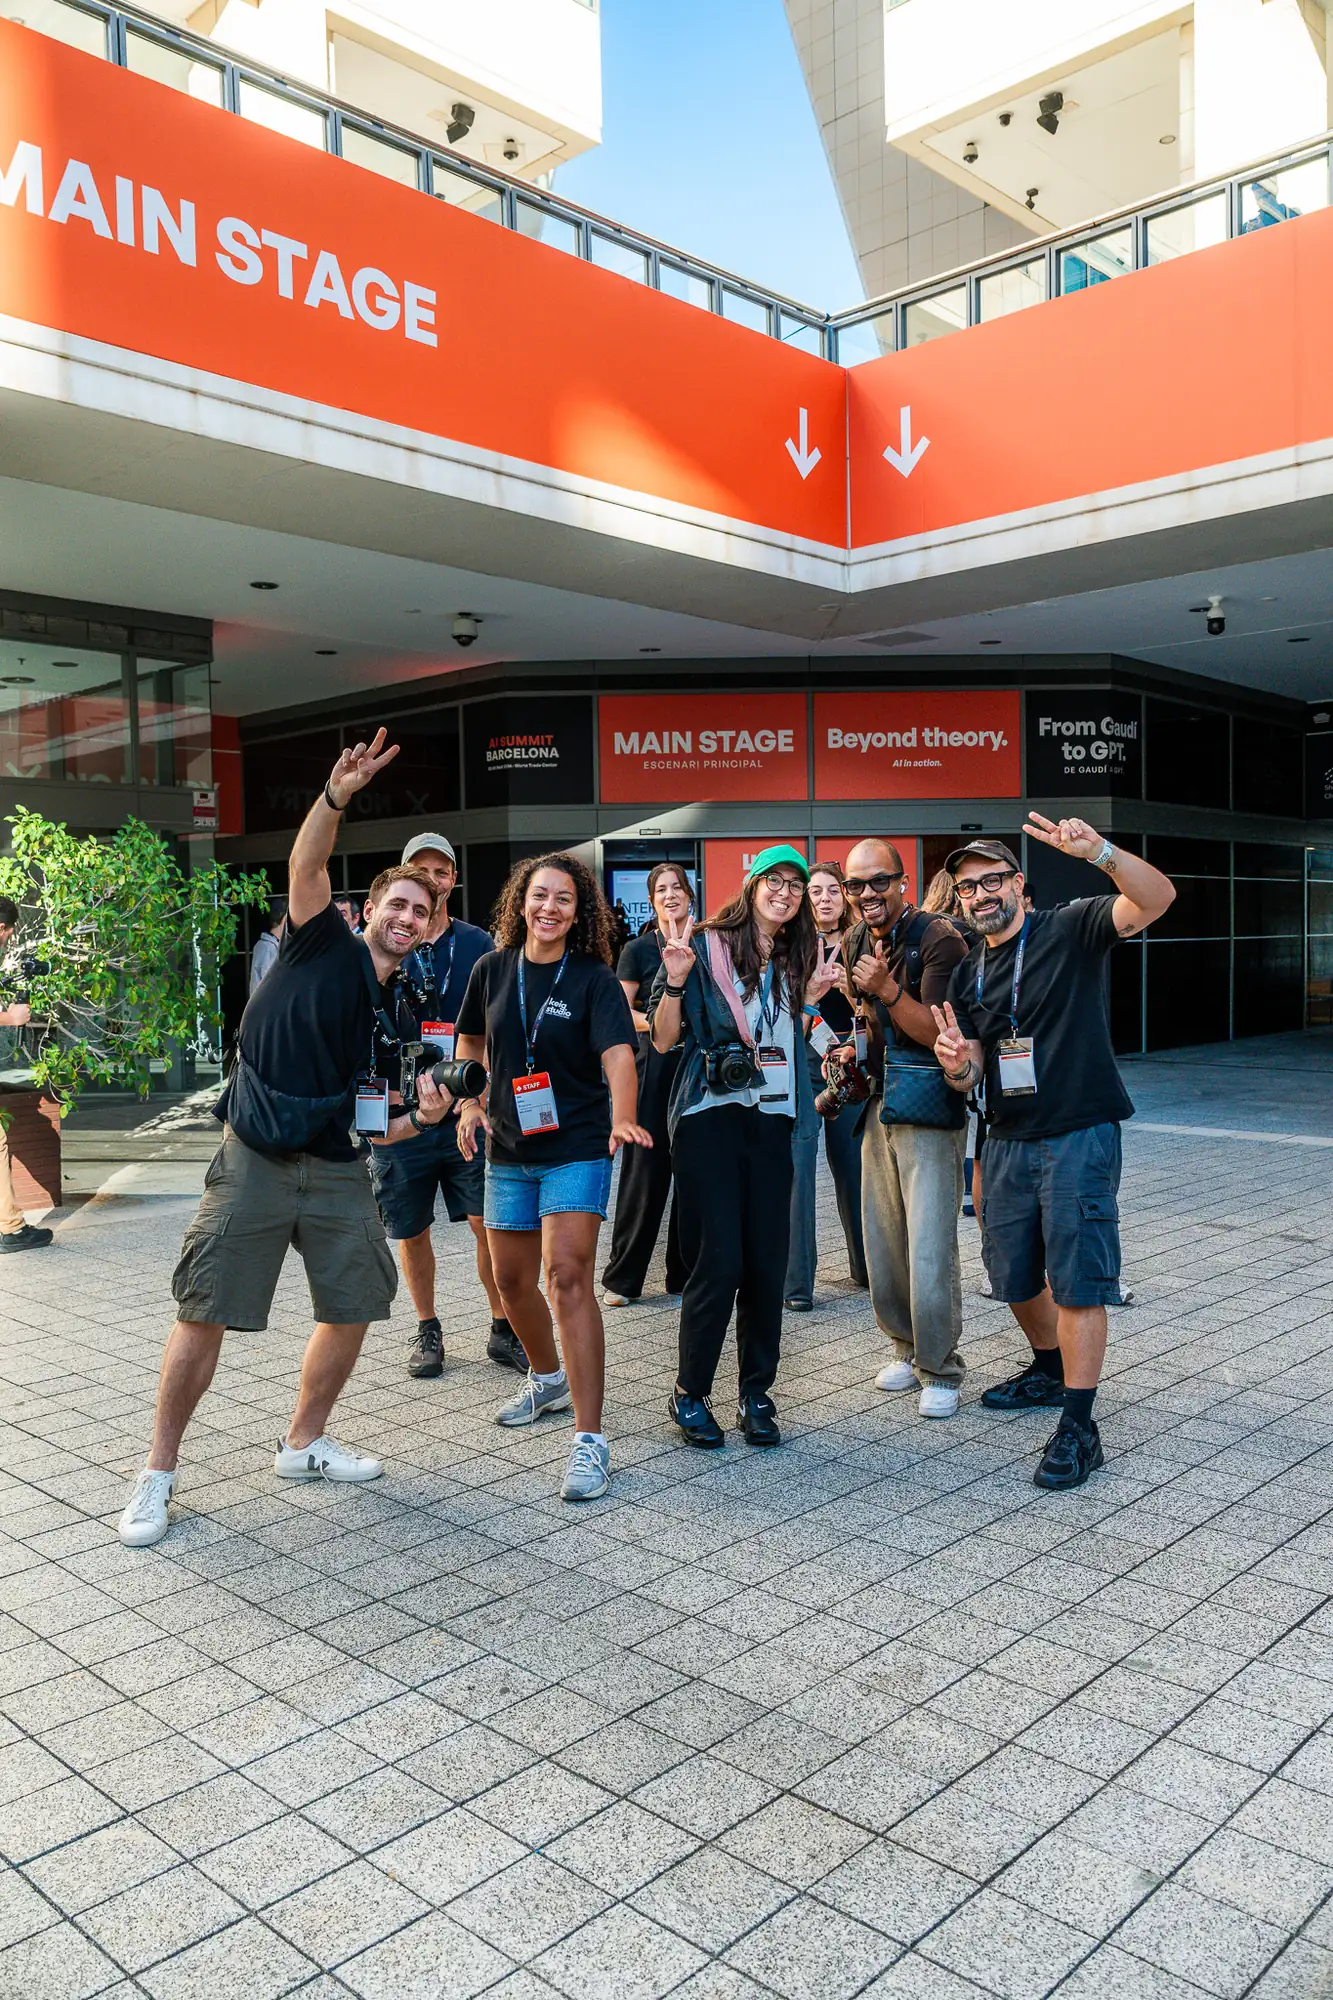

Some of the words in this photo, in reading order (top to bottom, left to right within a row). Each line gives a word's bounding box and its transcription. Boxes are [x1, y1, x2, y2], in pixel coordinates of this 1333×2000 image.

[0, 140, 197, 267] MAIN
[215, 216, 438, 348] STAGE
[1038, 717, 1097, 736] From
[1100, 716, 1138, 739] Gaudí
[488, 737, 499, 749] AI
[500, 734, 554, 747] SUMMIT
[614, 731, 692, 755] MAIN
[698, 729, 795, 753] STAGE
[827, 727, 918, 753] Beyond
[922, 727, 1008, 751] theory.
[485, 747, 560, 762] BARCELONA
[1061, 741, 1086, 760] to
[1090, 740, 1127, 762] GPT.
[643, 760, 700, 770] ESCENARI
[703, 759, 764, 769] PRINCIPAL
[892, 759, 903, 767] AI
[903, 759, 912, 767] in
[912, 758, 942, 767] action.
[1063, 766, 1076, 774] DE
[1078, 764, 1108, 774] GAUDÍ
[545, 1006, 572, 1017] studio
[522, 1081, 541, 1091] STAFF
